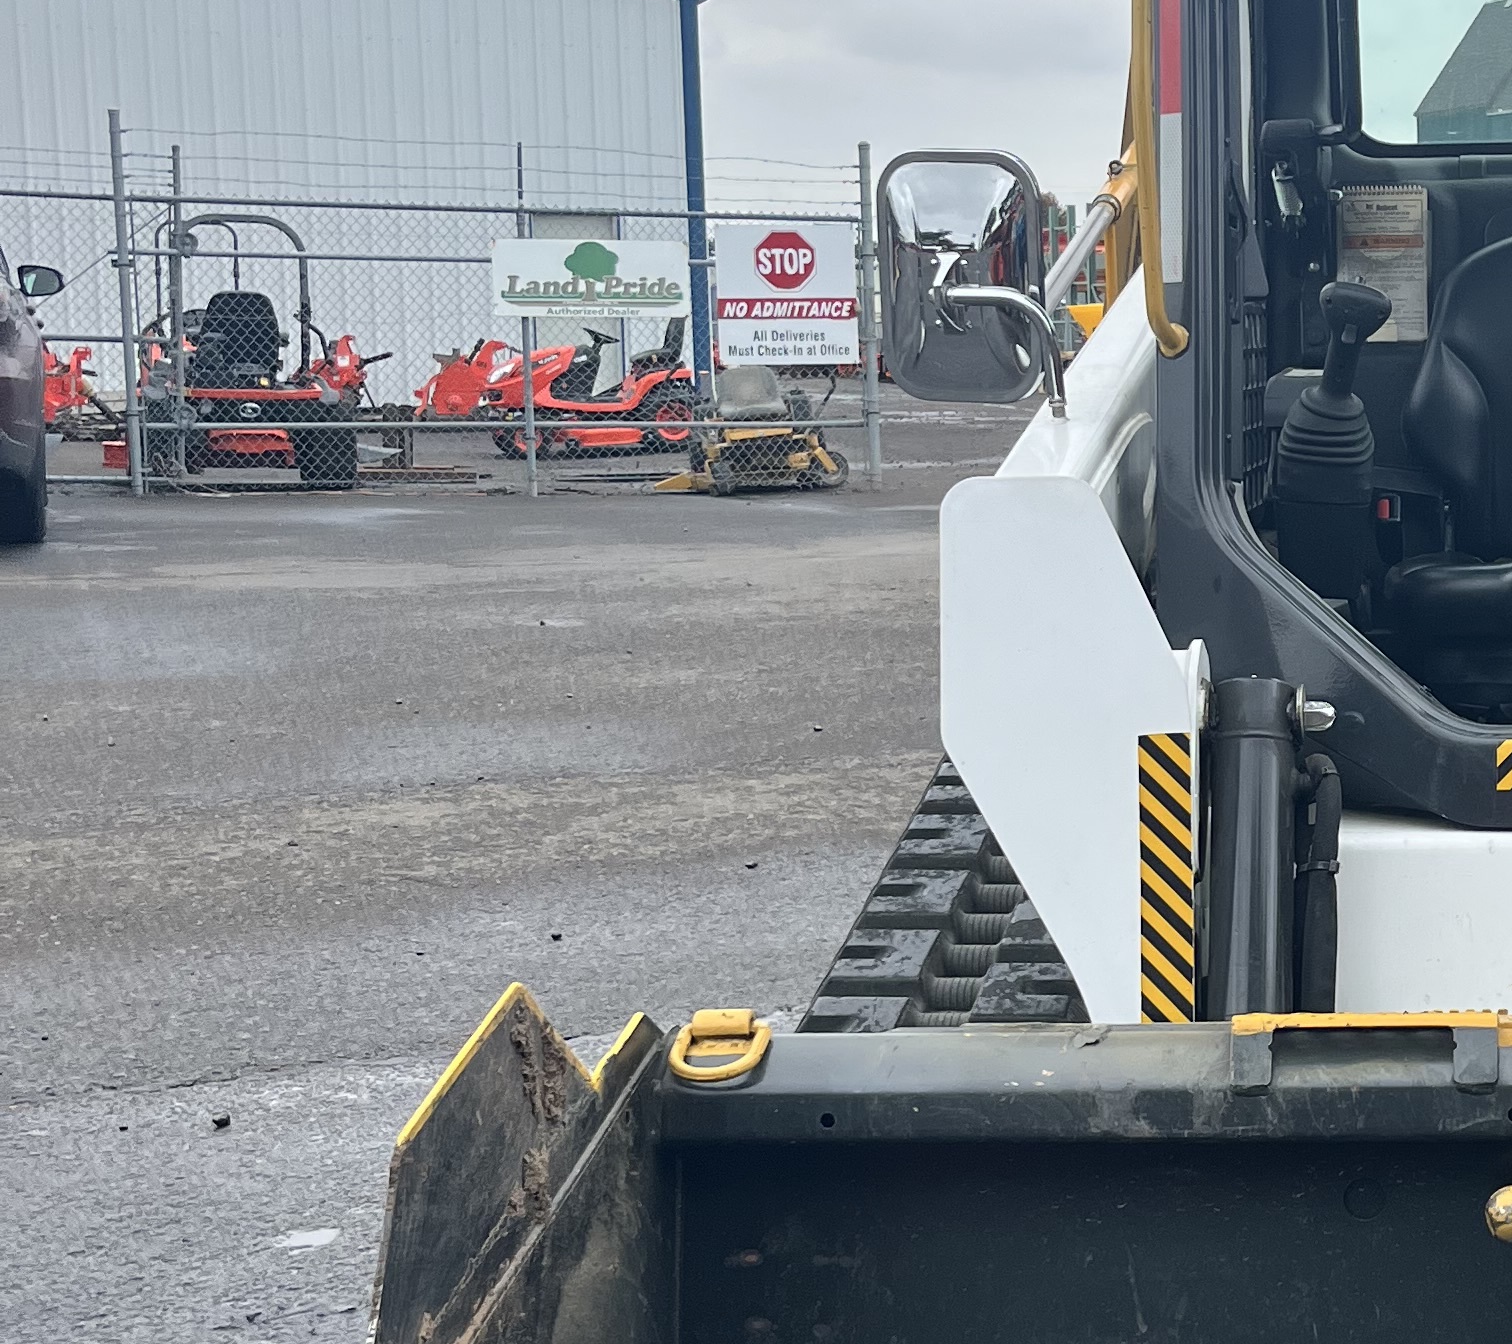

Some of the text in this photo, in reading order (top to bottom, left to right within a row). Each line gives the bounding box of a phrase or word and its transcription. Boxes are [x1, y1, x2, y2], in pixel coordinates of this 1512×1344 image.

[758, 248, 813, 275] STOP
[507, 275, 681, 298] Land Pride
[546, 307, 641, 316] Authorized Dealer
[723, 301, 853, 318] NO ADMITTANCE
[753, 330, 826, 342] All Deliveries
[728, 343, 850, 357] Must Check-In at Office
